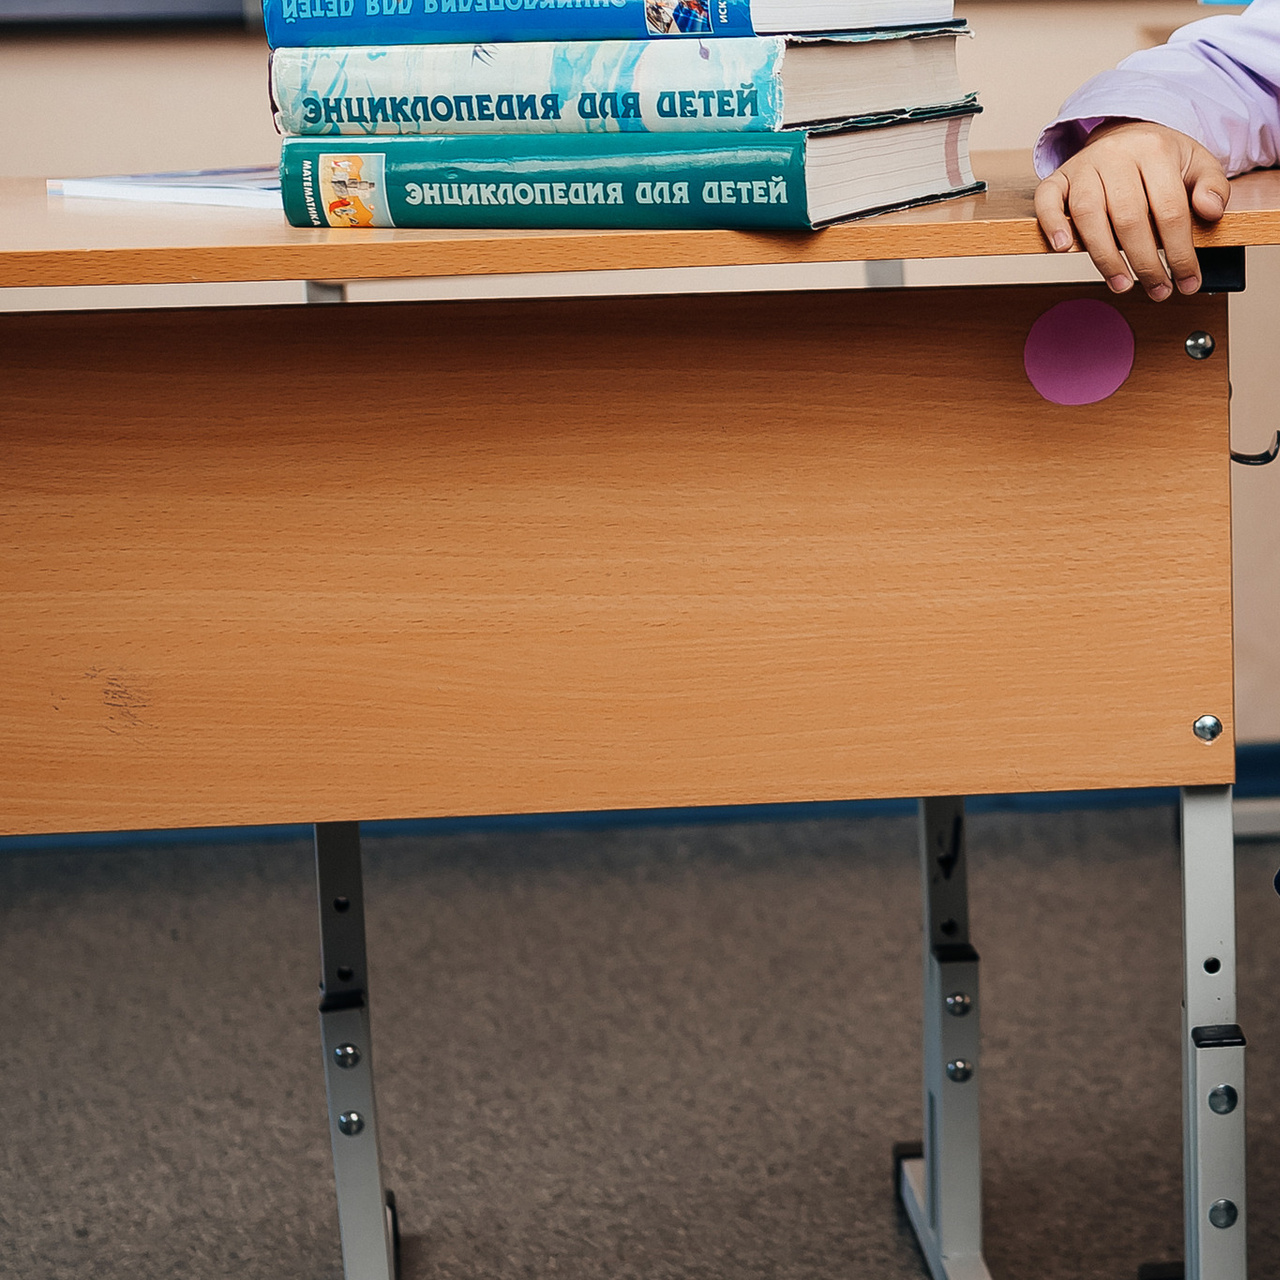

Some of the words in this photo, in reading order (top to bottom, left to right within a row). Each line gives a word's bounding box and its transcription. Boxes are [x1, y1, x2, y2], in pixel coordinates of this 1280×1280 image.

[302, 93, 560, 125] ЭНЦИКЛОПЕДИЯ
[577, 91, 642, 120] ДЛЯ
[656, 82, 759, 119] ДЕТЕЙ
[302, 160, 321, 226] МАТЕМАТИКА
[404, 181, 624, 206] ЭНЦИКЛОПЕДИЯ
[635, 181, 691, 205] ДЛЯ
[702, 175, 789, 205] ДЕТЕЙ
